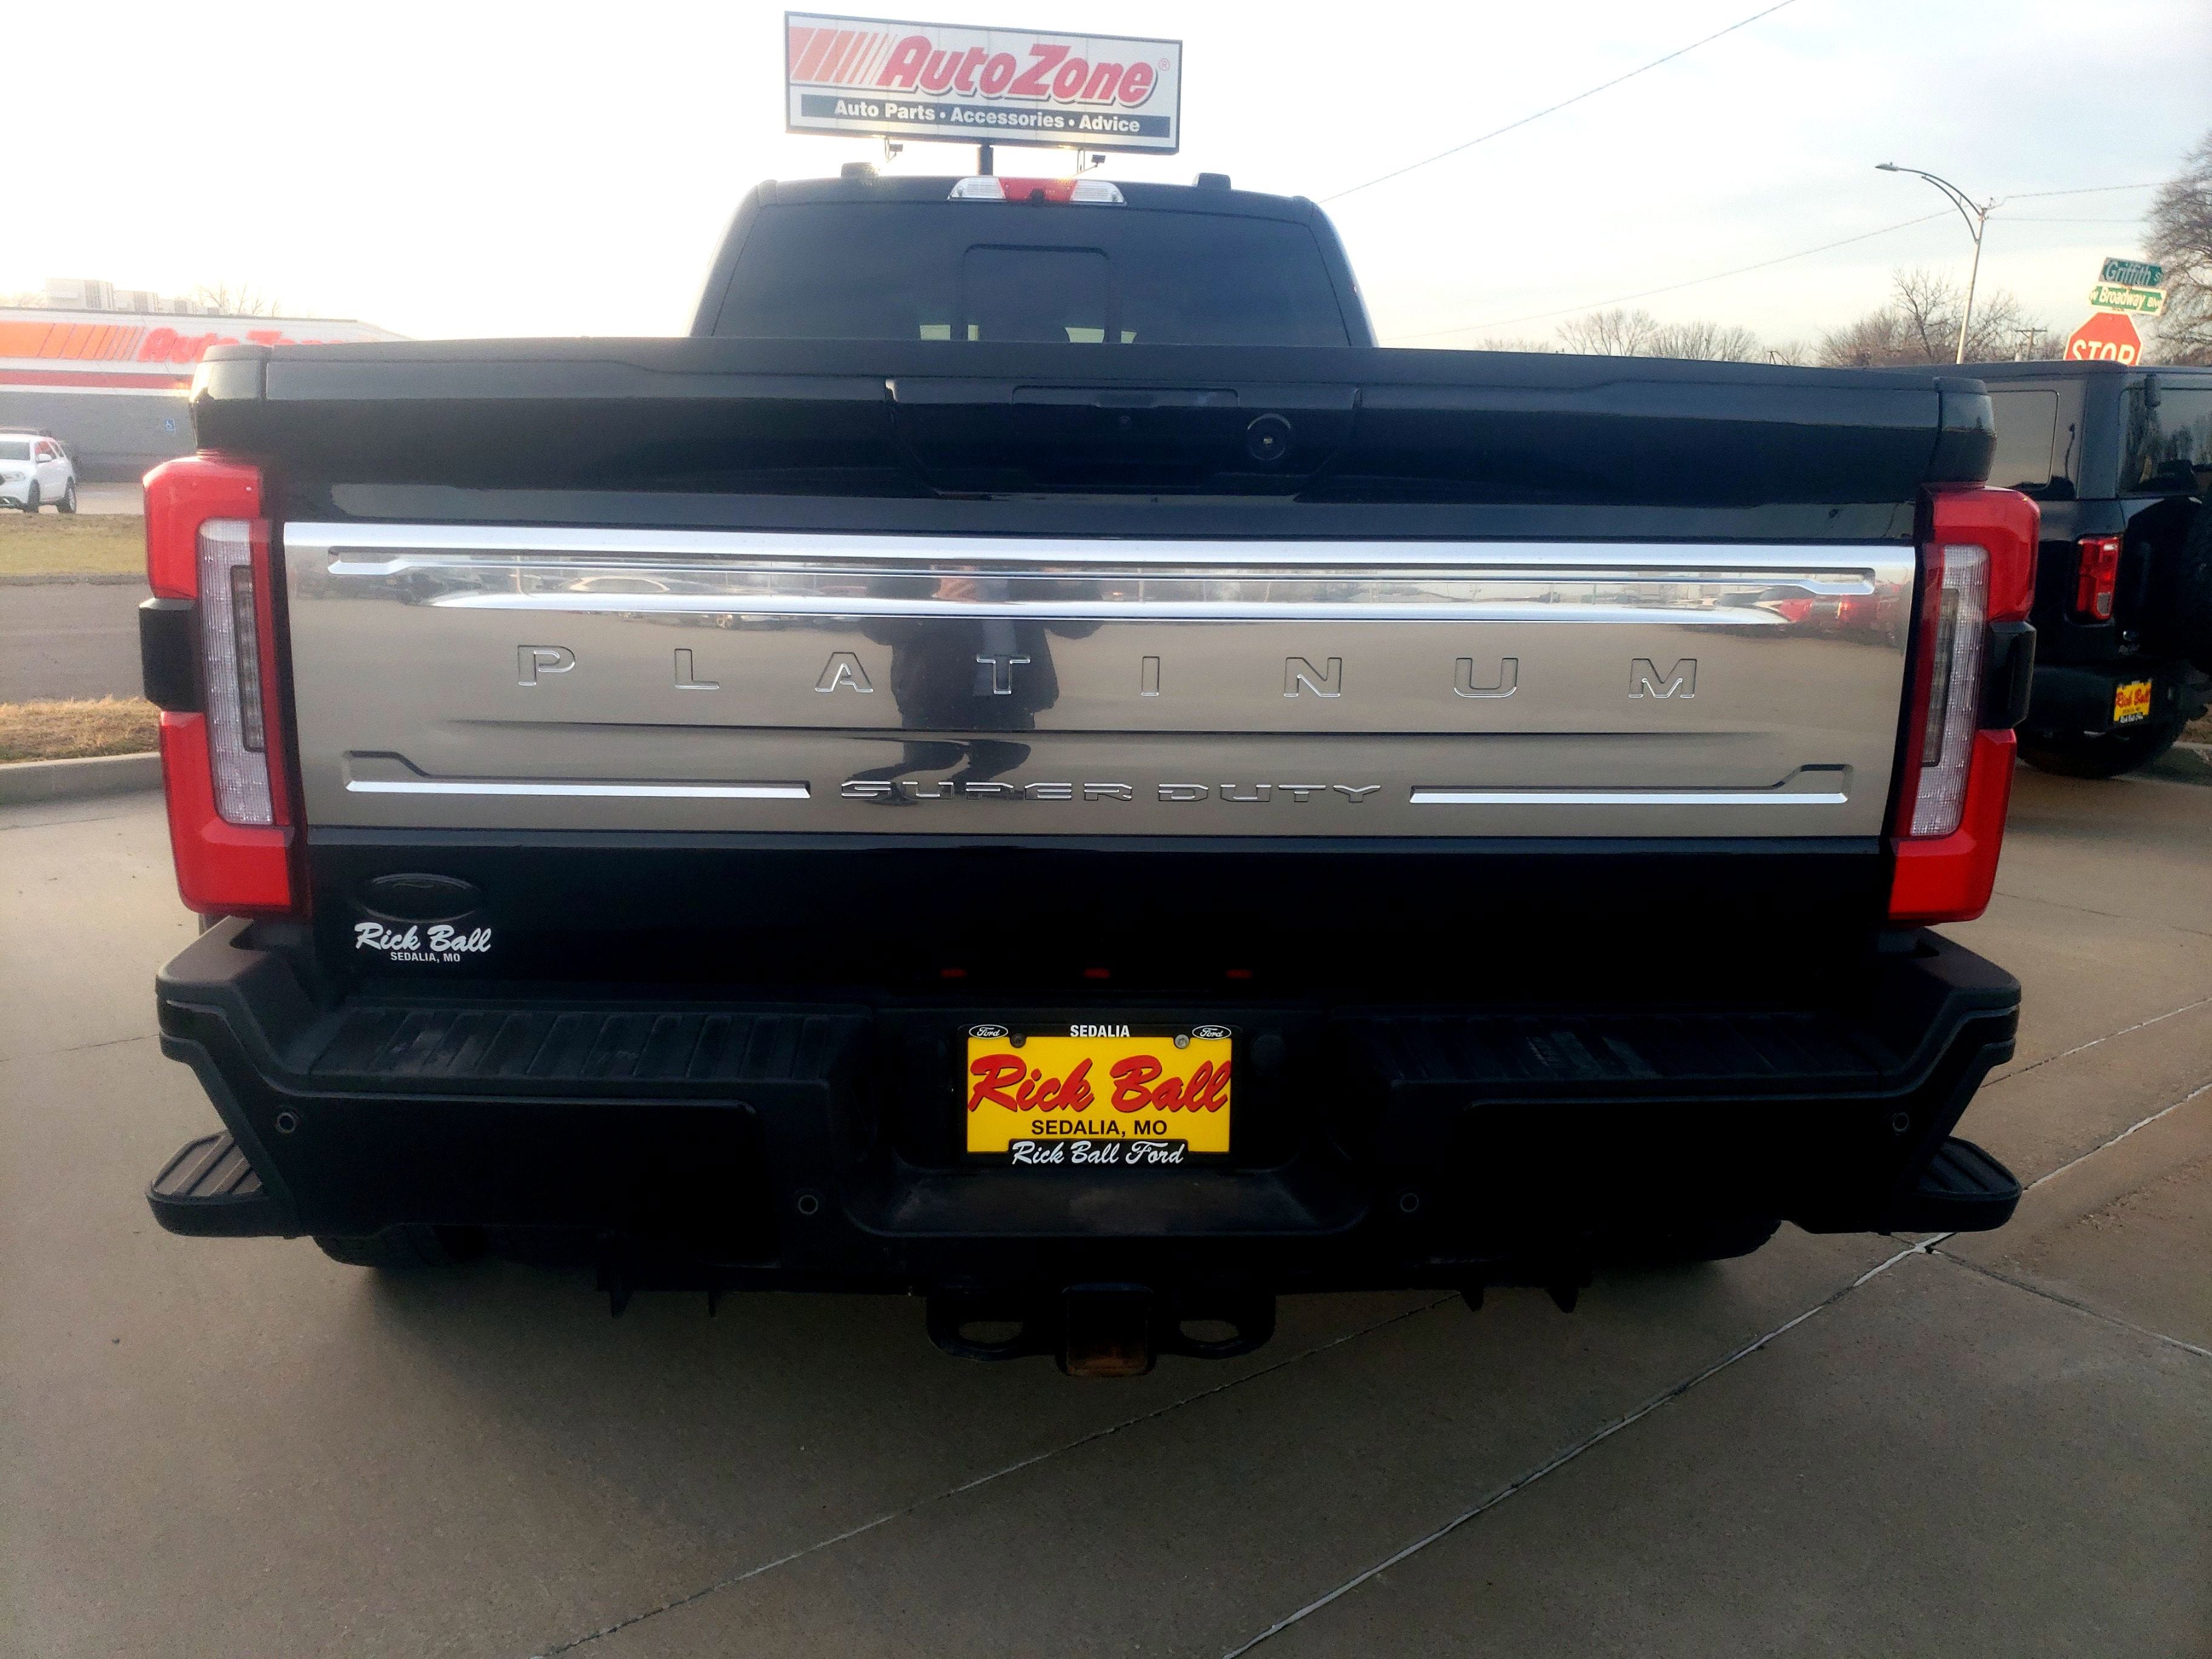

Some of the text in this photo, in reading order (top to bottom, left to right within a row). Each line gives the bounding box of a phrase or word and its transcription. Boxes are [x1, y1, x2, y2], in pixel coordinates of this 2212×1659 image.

[877, 35, 1155, 104] AutoZone
[834, 99, 1140, 132] Auto Parts Accessories Advice
[2099, 286, 2146, 311] Broadway
[2073, 339, 2135, 366] STOP
[517, 645, 1697, 699] PLATINUM
[842, 780, 1381, 803] SUPER DUTY
[354, 922, 493, 953] Rick Ball
[391, 951, 461, 963] SEDALIA, MO
[976, 1026, 1001, 1038] Ford
[1070, 1025, 1130, 1038] SEDALIA
[1199, 1027, 1224, 1038] Ford
[968, 1054, 1231, 1113] Rick Ball
[1031, 1120, 1167, 1138] SEDALIA, MO
[1012, 1140, 1184, 1165] Rick Ball Ford
